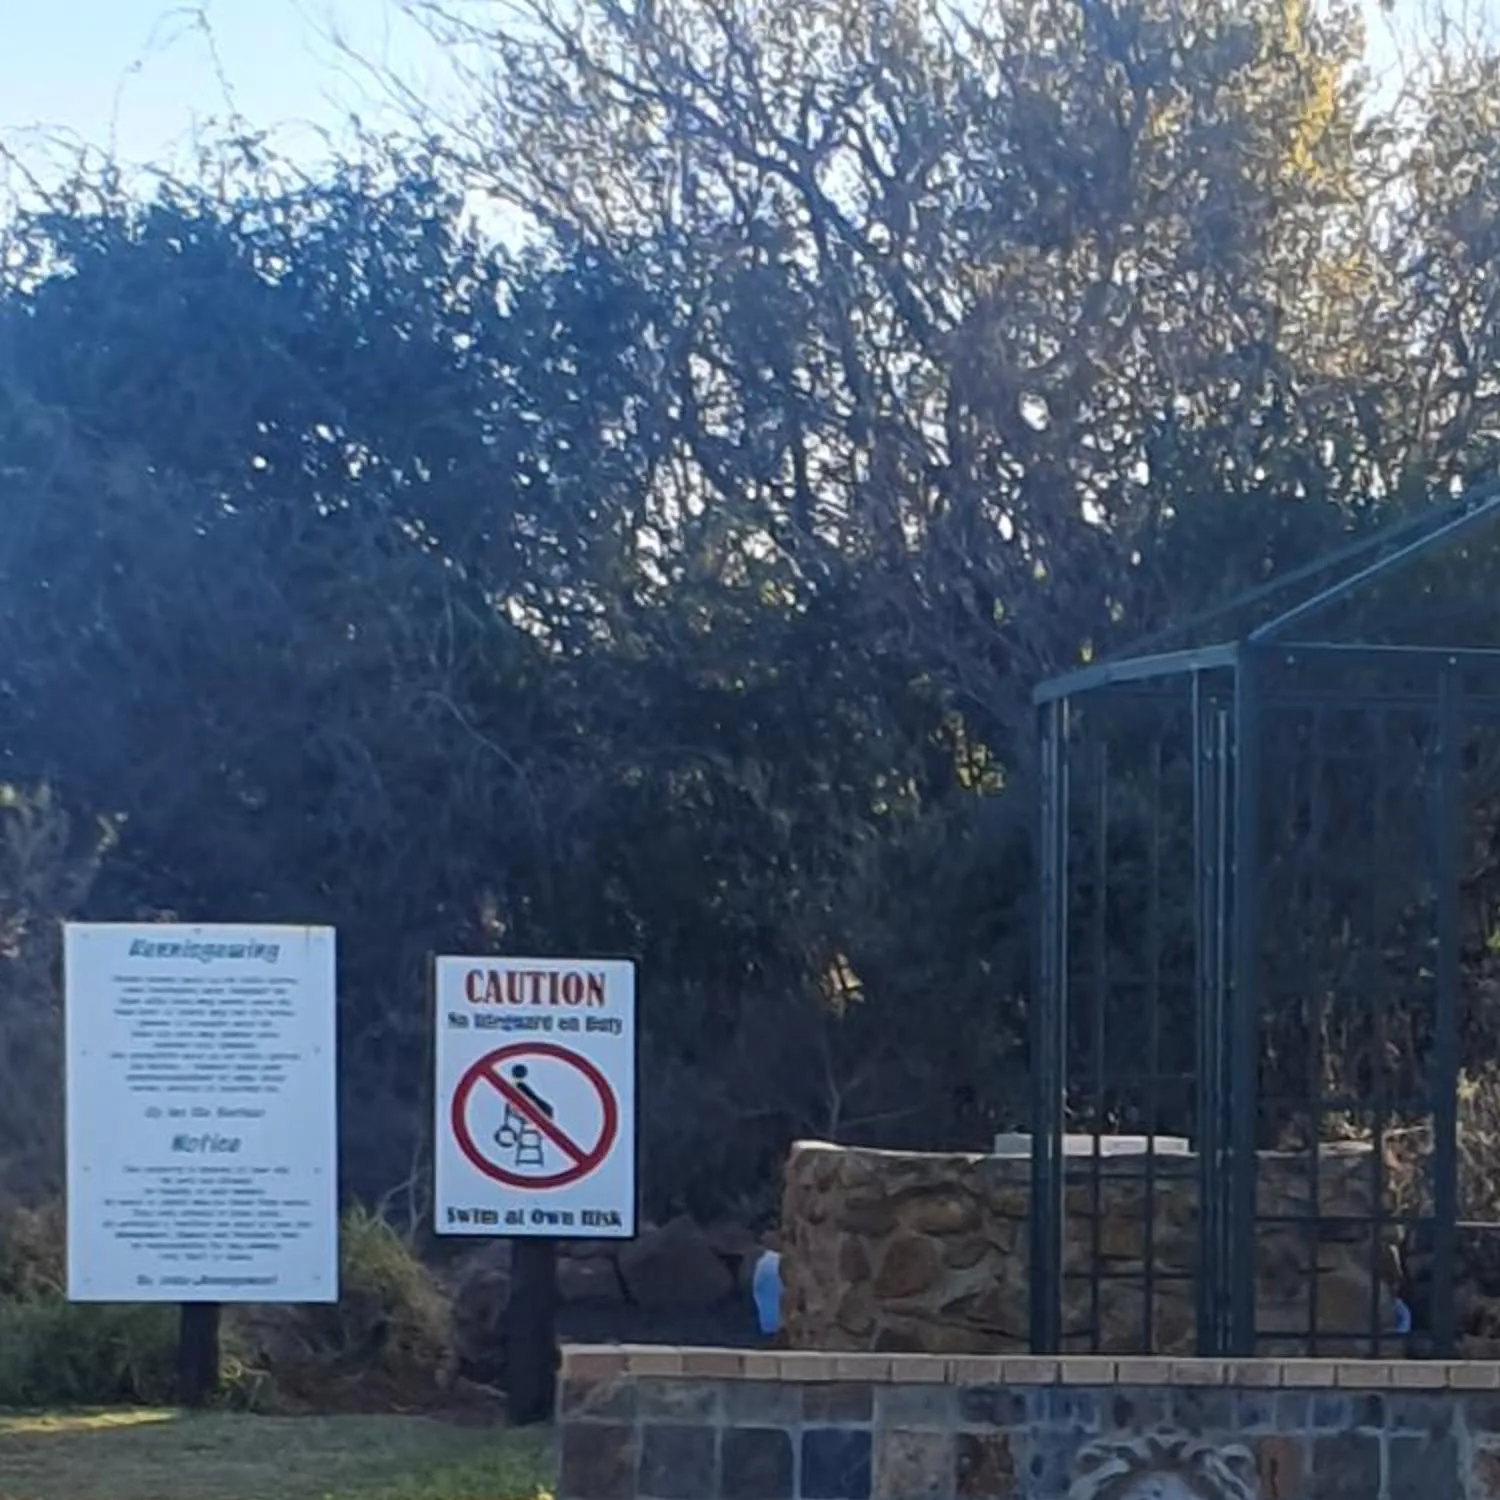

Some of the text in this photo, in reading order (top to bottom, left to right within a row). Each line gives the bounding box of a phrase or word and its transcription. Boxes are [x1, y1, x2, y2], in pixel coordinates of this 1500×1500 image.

[466, 970, 606, 1006] CAUTION
[447, 1012, 468, 1028] No
[172, 1133, 241, 1153] Notice
[447, 1206, 498, 1225] Swim
[531, 1209, 574, 1225] Own
[582, 1209, 622, 1228] Risk
